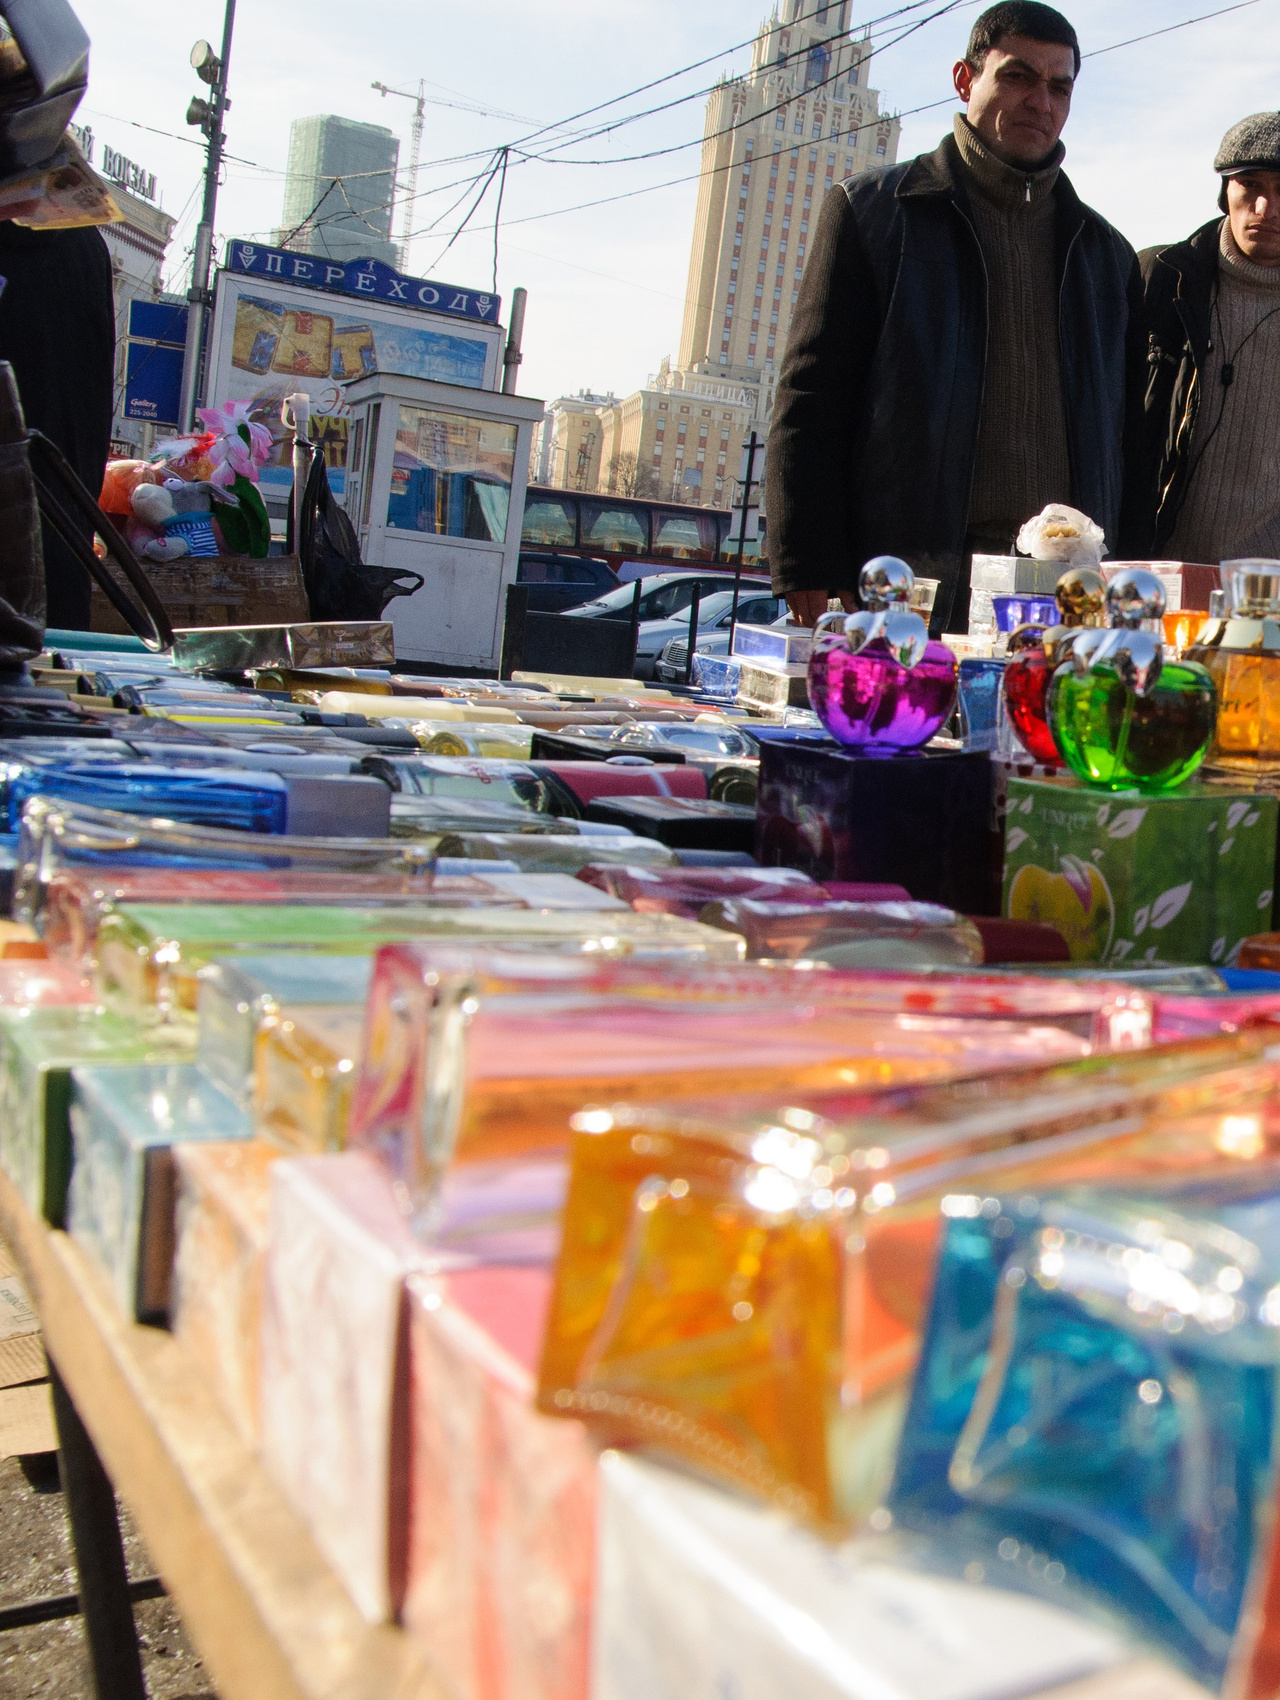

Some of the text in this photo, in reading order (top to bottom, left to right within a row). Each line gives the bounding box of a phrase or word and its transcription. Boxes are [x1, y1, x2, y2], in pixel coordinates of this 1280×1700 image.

[102, 144, 158, 201] ВОКЗАЛ
[264, 252, 470, 313] ПЕРЕХОД
[129, 408, 158, 418] 225-2040
[130, 398, 158, 410] Gallery
